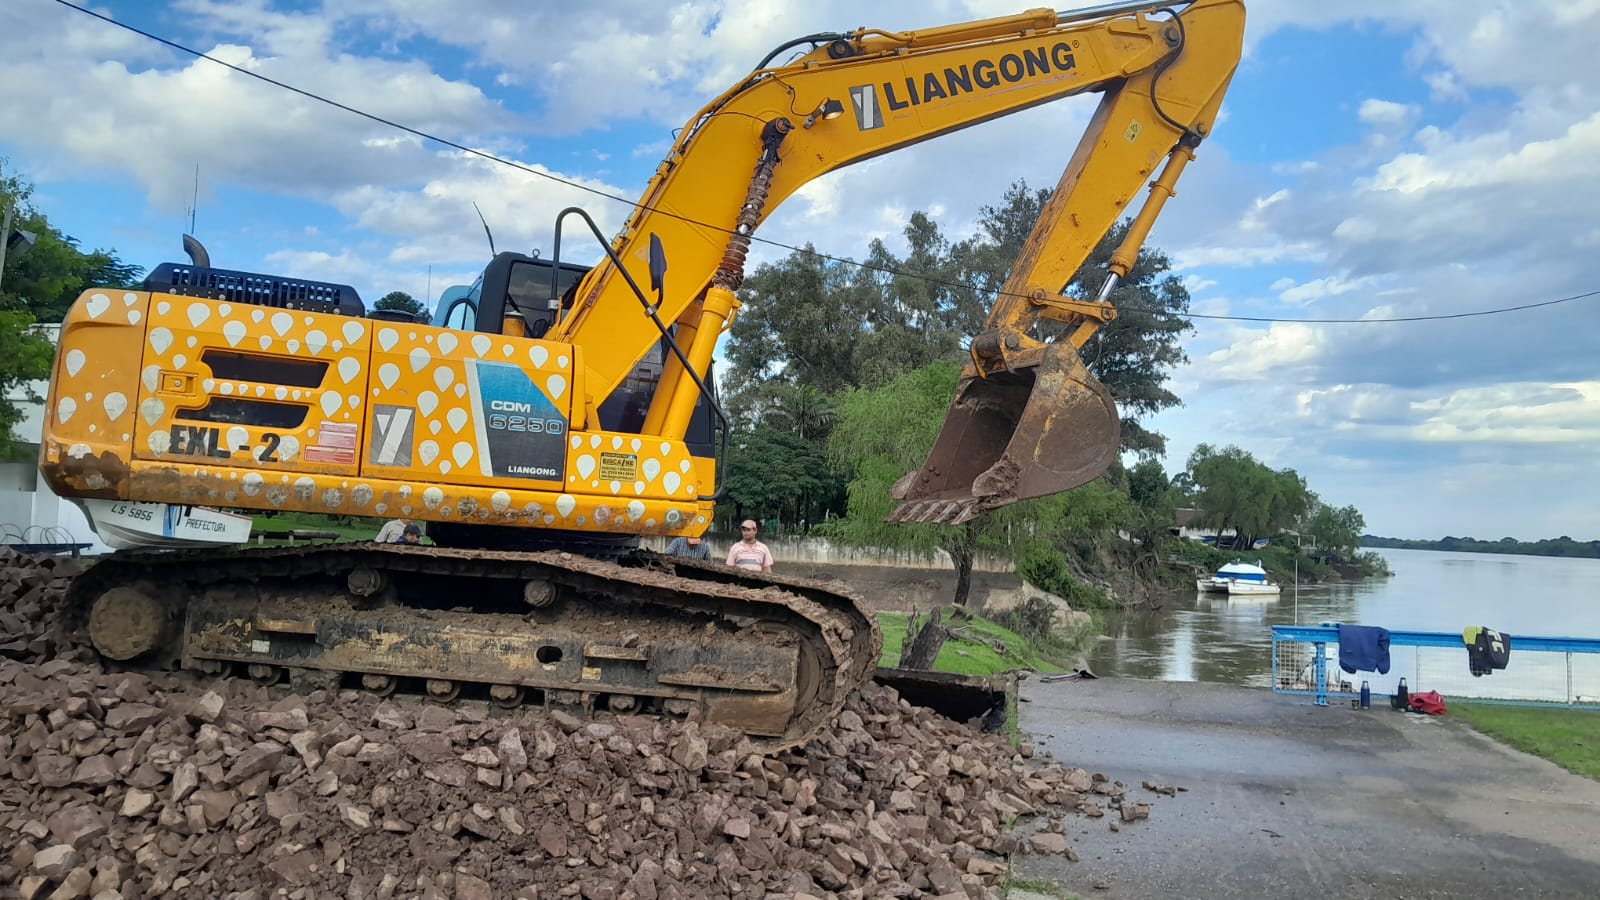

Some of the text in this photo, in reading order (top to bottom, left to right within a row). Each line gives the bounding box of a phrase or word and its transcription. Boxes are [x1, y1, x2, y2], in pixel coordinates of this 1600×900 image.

[883, 42, 1077, 112] LIANGONG
[491, 400, 531, 413] CDM
[489, 413, 563, 435] 6250
[507, 465, 557, 476] LIANGONG
[111, 503, 154, 521] LS 5856
[185, 518, 226, 533] PREFECTURA
